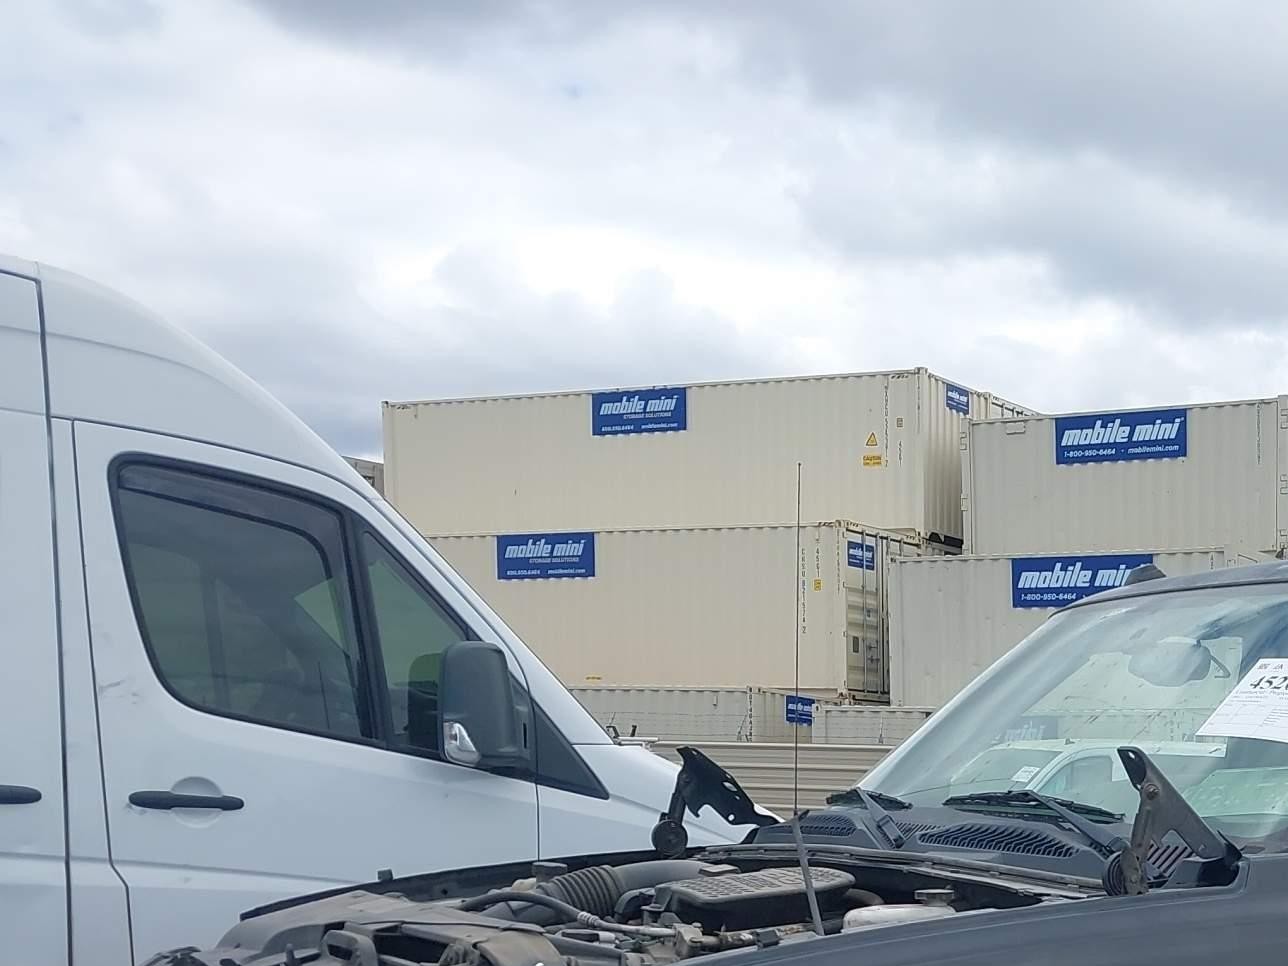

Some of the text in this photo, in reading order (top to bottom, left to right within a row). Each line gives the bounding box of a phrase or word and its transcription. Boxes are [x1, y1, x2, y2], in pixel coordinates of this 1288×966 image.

[600, 395, 679, 415] mobile mini
[1060, 418, 1181, 447] mobile mini
[1064, 444, 1180, 458] 1-800-950-6464 mobilemini.com
[505, 538, 585, 558] mobile mini
[1018, 562, 1092, 588] mobile
[1021, 593, 1076, 601] 1-800-950-6464
